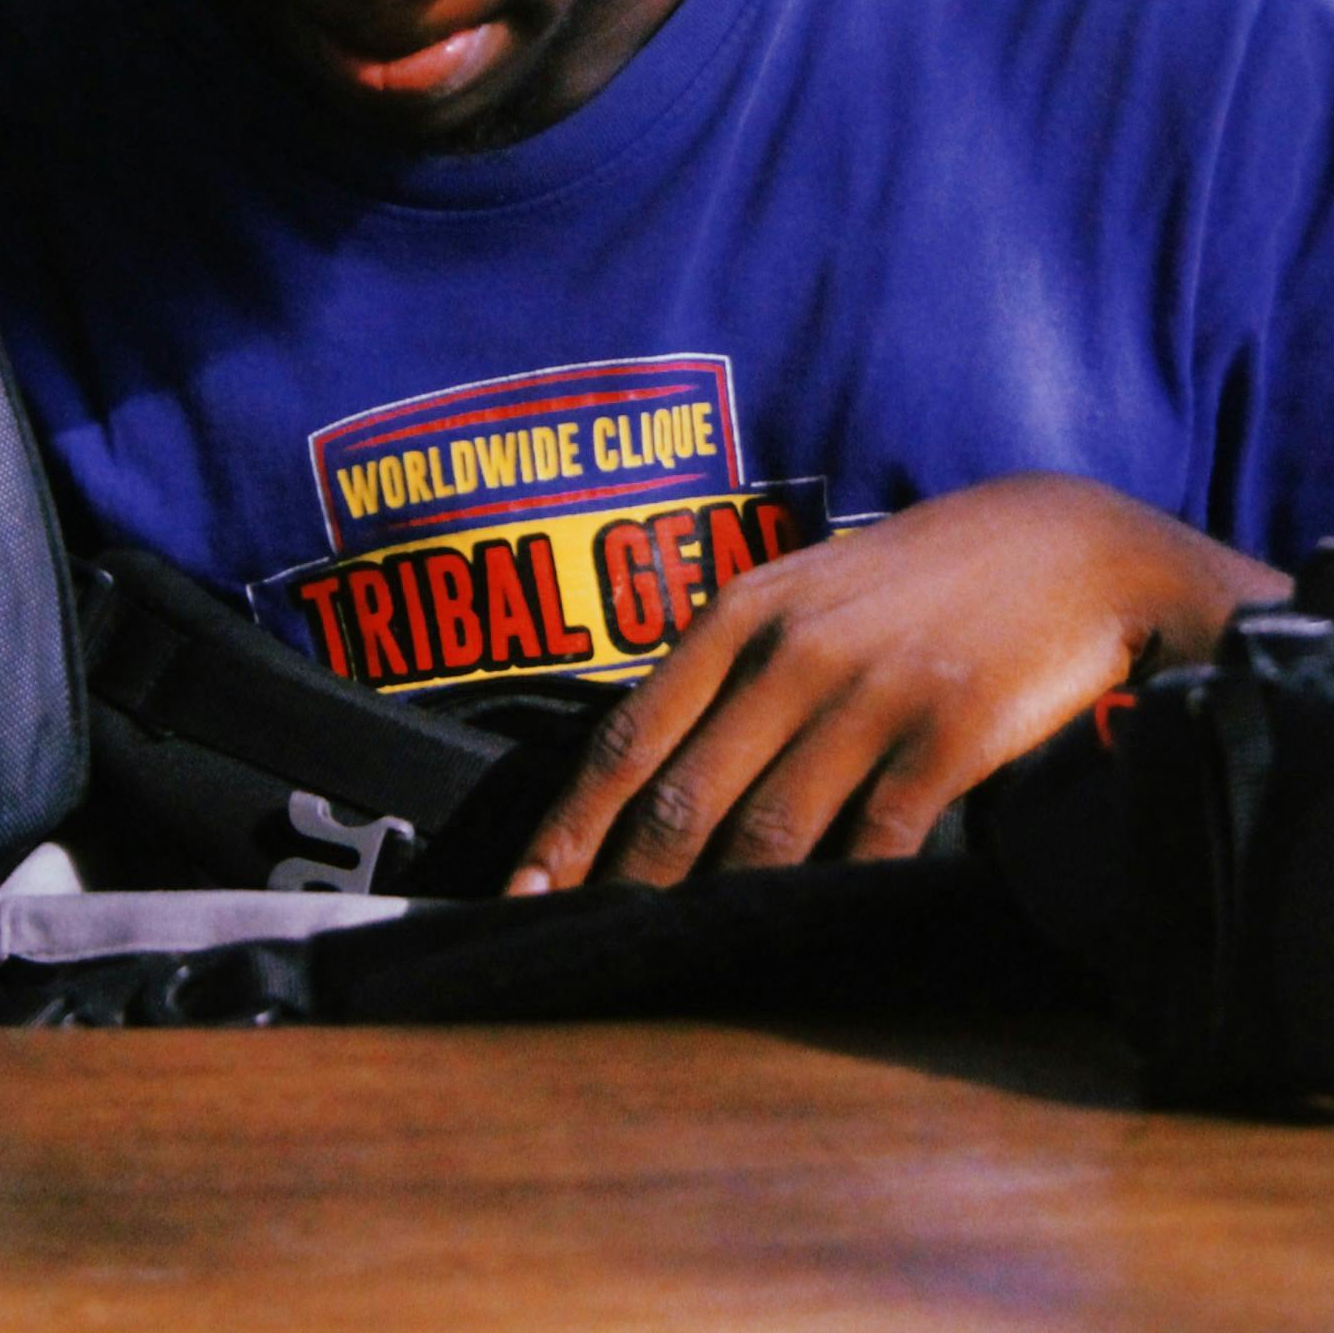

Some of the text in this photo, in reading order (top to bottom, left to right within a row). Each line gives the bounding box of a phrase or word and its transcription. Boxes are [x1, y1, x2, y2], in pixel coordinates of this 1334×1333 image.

[337, 402, 717, 519] WORLDWIDE CLIQUE
[301, 539, 592, 680] TRIBAL
